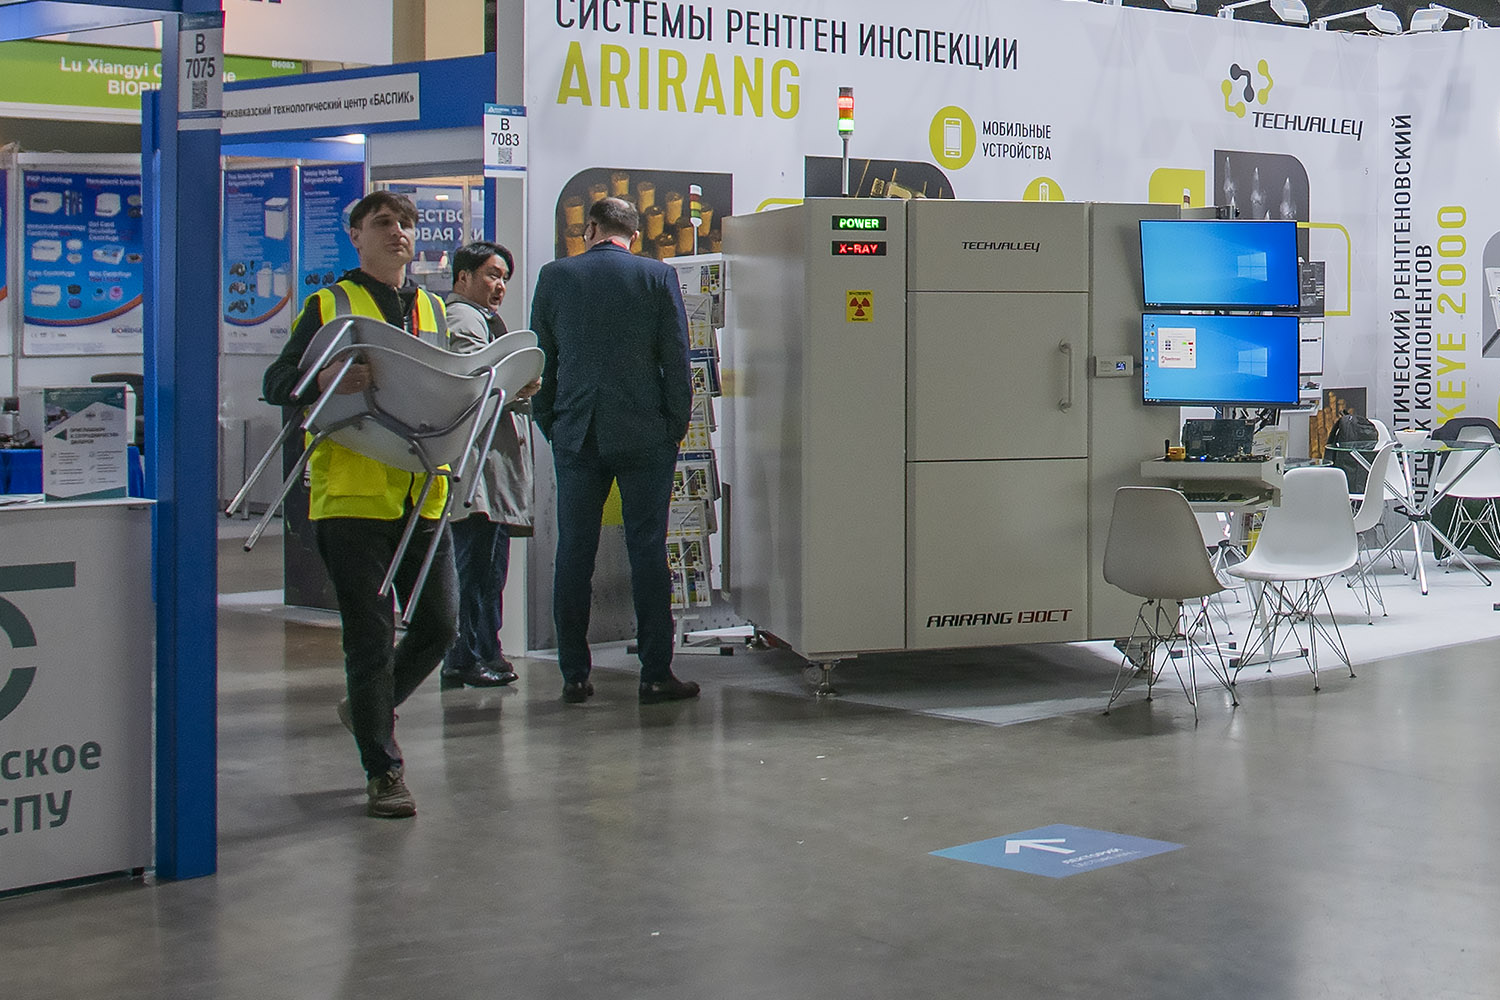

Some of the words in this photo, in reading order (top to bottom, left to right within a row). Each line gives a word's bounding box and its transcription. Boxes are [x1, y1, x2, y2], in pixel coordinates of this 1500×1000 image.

[195, 33, 206, 54] B
[726, 8, 847, 55] РЕНТГЕН
[858, 22, 1019, 71] ИНСПЕКЦИИ
[60, 57, 82, 72] Lu
[87, 58, 149, 78] Xiangyi
[185, 57, 216, 79] 7075
[556, 41, 800, 120] ARIRANG
[222, 104, 272, 119] икавказский
[273, 102, 342, 117] технологический
[343, 97, 368, 110] центр
[369, 90, 415, 107] «БАСПИК»
[500, 118, 510, 131] B
[982, 120, 1052, 139] МОБИЛЬНЫЕ
[1252, 111, 1364, 141] TECHVALLEY
[490, 132, 520, 147] 7083
[982, 141, 1052, 160] УСТРОЙСТВА
[1391, 114, 1412, 300] РЕНТГЕНОВСКИЙ
[839, 218, 880, 229] POWER
[839, 243, 879, 254] X-RAY
[961, 241, 1041, 253] TECHVALLEY
[1437, 205, 1467, 314] 2000
[1414, 244, 1433, 410] КОМПОНЕНТОВ
[1437, 333, 1467, 425] KEYE
[926, 611, 1013, 628] ARIRANG
[1017, 609, 1073, 624] 130CT
[1, 741, 103, 781] ское
